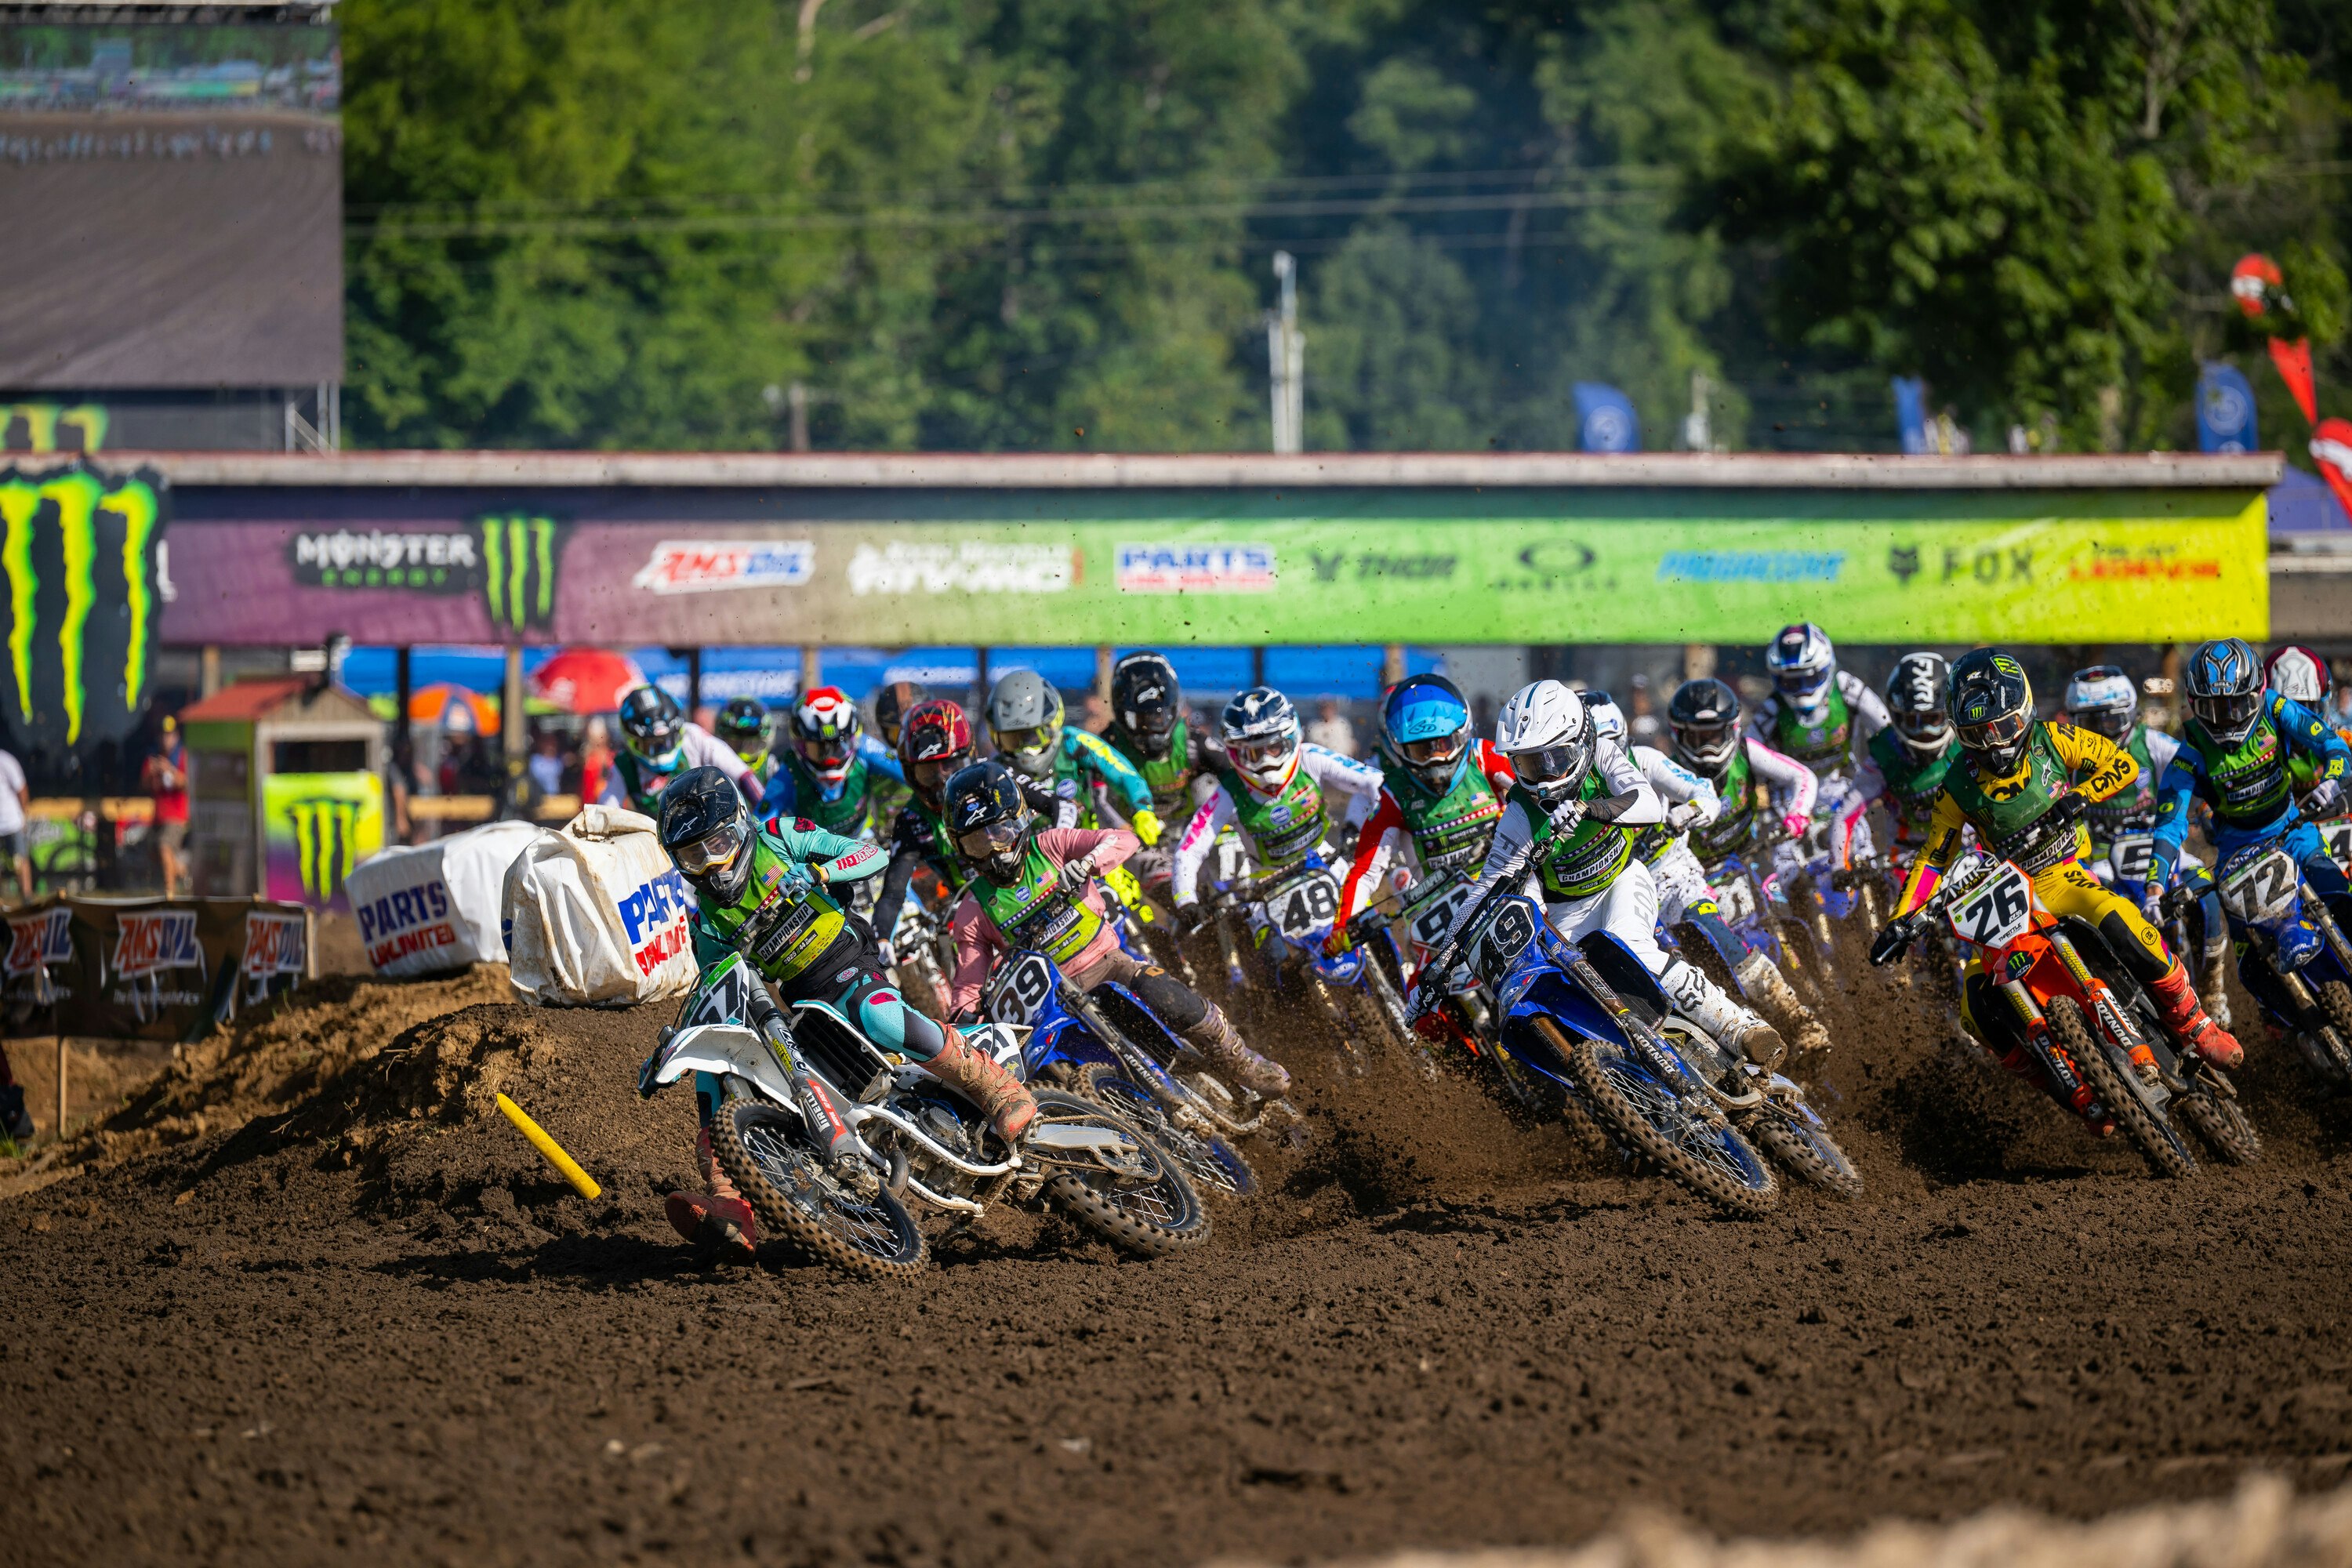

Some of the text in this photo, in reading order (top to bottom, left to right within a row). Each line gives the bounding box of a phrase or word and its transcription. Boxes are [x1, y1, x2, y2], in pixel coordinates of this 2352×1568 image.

[296, 532, 476, 568] MONSTER
[1942, 546, 2034, 583] FOX
[1533, 844, 1545, 862] ASV
[1563, 838, 1624, 882] CHAMPIONSHIP
[358, 880, 448, 942] PARTS
[1283, 881, 1338, 932] 48
[1633, 874, 1654, 931] FOX
[1965, 873, 2029, 944] 26
[2227, 856, 2297, 924] 72
[116, 916, 197, 974] AMSOIL
[245, 916, 306, 973] AMSOIL
[368, 923, 456, 970] UNLIMITED
[760, 905, 810, 960] CHAMPIONSHIP
[784, 951, 797, 964] 2025
[997, 959, 1050, 1025] 39
[2096, 1000, 2133, 1047] DUNLO
[1123, 1052, 1162, 1091] DUNLOP
[1633, 1033, 1675, 1074] DUNLOP
